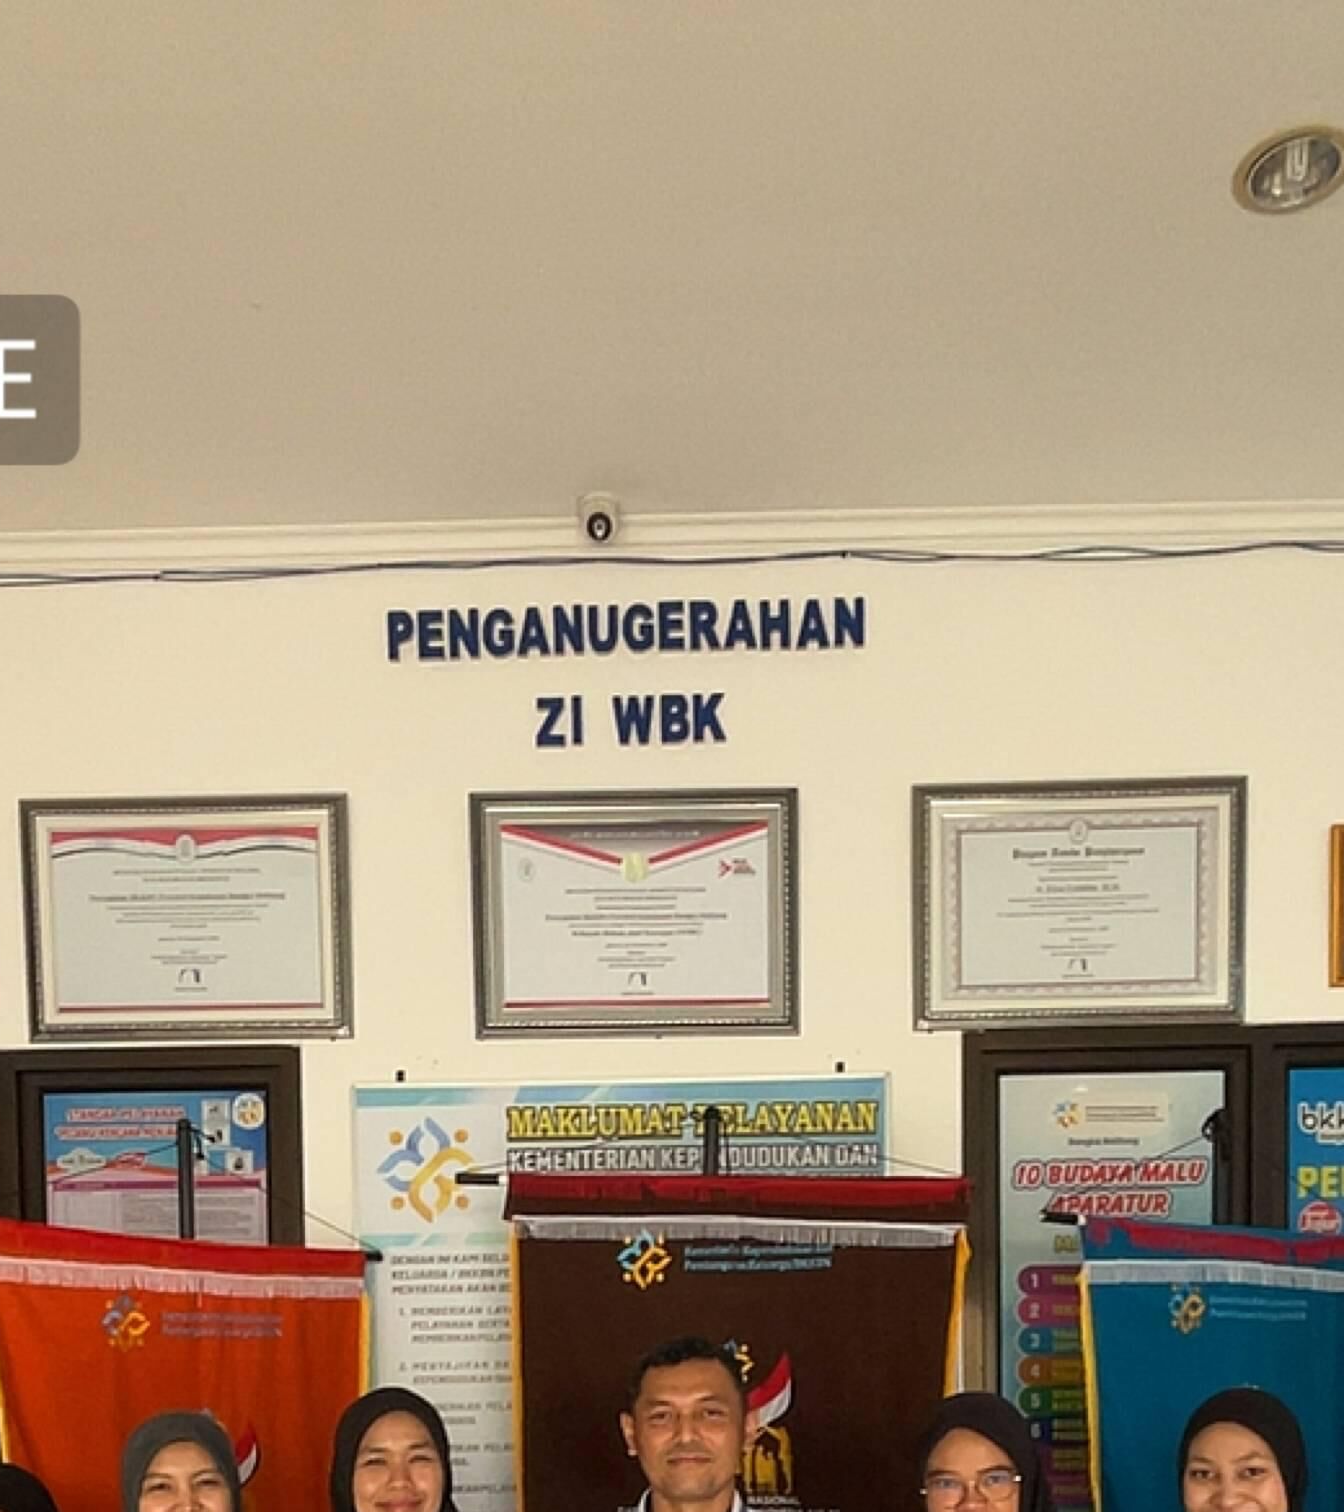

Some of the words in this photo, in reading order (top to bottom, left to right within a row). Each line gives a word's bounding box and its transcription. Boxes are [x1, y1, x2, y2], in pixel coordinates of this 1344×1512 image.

[386, 597, 866, 661] PENGANUGERAHAN
[536, 697, 582, 748] ZI
[611, 693, 727, 746] WBK
[507, 1104, 685, 1141] MAKLUMAT
[510, 1147, 656, 1172] KEMENTERIAN
[660, 1145, 830, 1170] KEPDUDUKAN
[1046, 1161, 1135, 1186] BUDAYA
[1138, 1160, 1206, 1185] MALU
